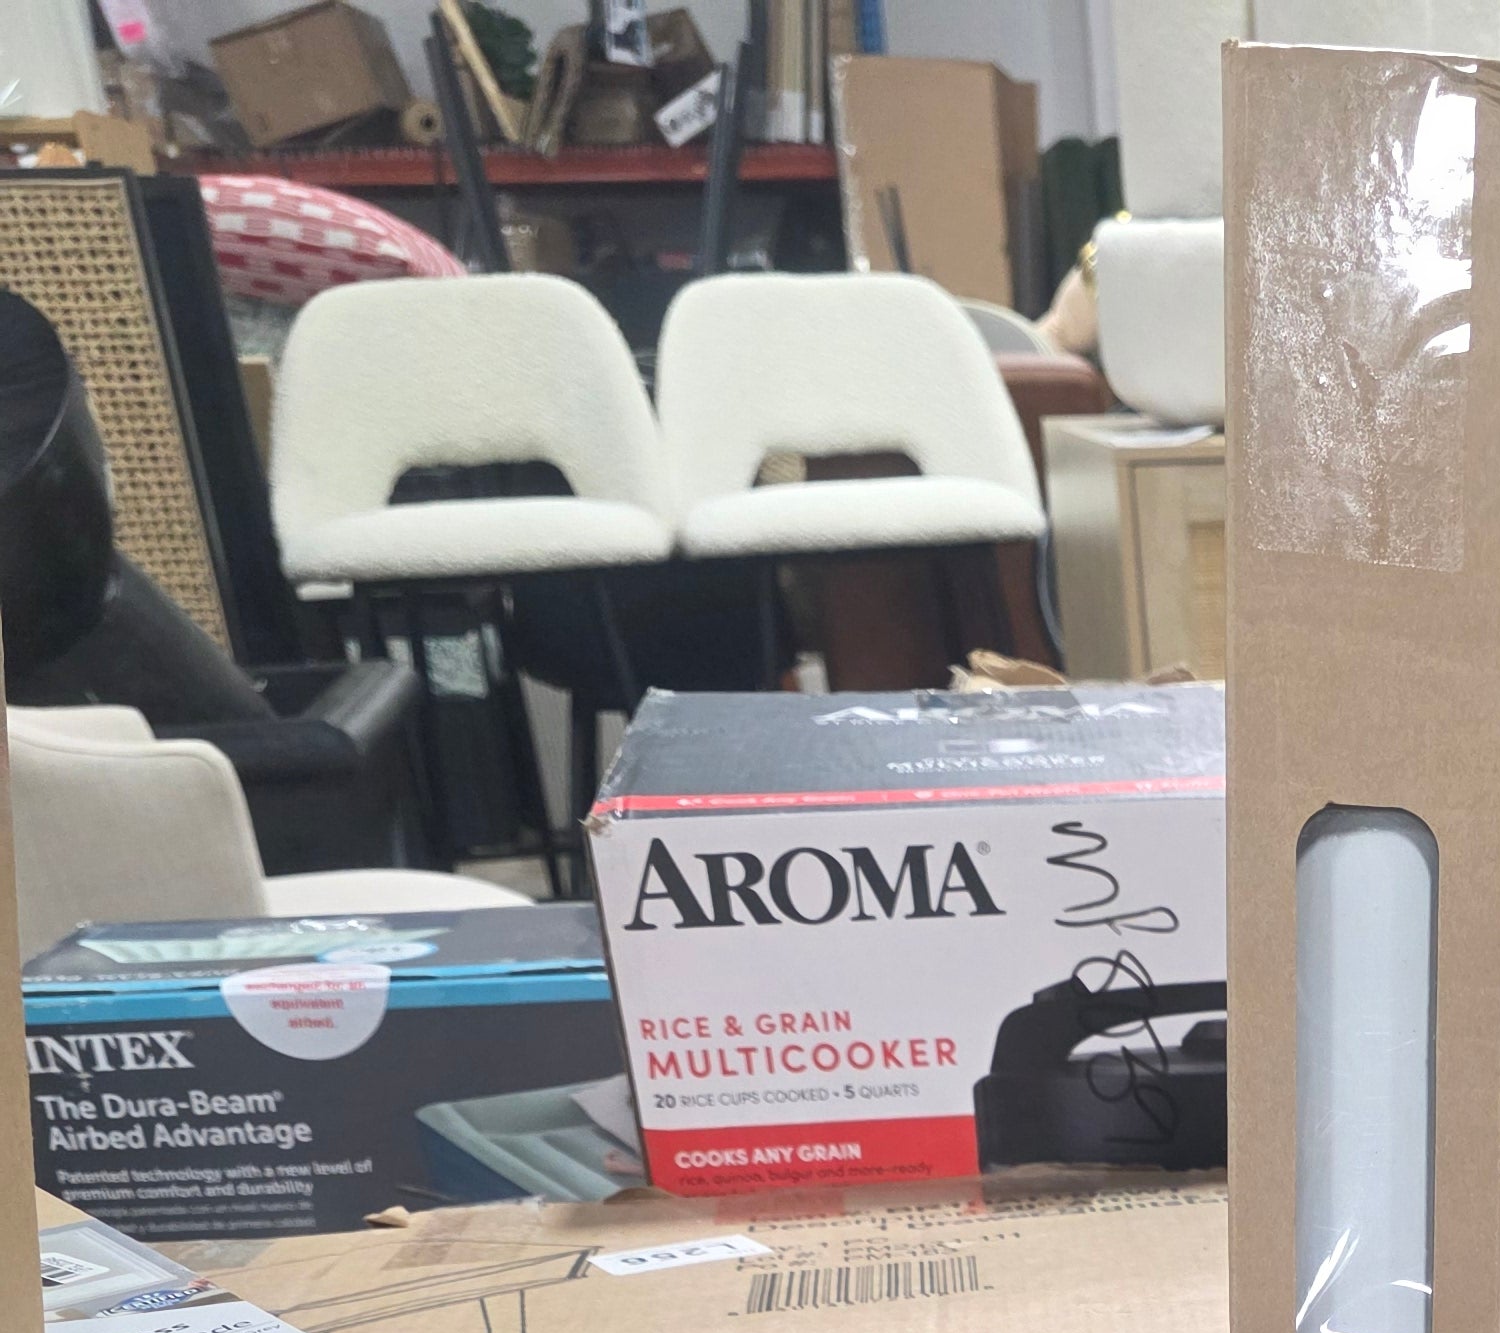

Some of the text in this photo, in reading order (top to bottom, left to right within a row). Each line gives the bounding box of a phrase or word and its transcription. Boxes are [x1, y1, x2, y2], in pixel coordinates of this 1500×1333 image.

[639, 1009, 852, 1042] RICE & GRAIN
[26, 1030, 196, 1075] INTEX
[647, 1037, 958, 1080] MULTICOOKER
[35, 1094, 96, 1121] The
[655, 1083, 920, 1109] 20 RICE CUPS COOKED 5 QUARTS
[49, 1122, 313, 1151] Airbed Advantage
[674, 1144, 862, 1169] COOKS ANY GRAIN
